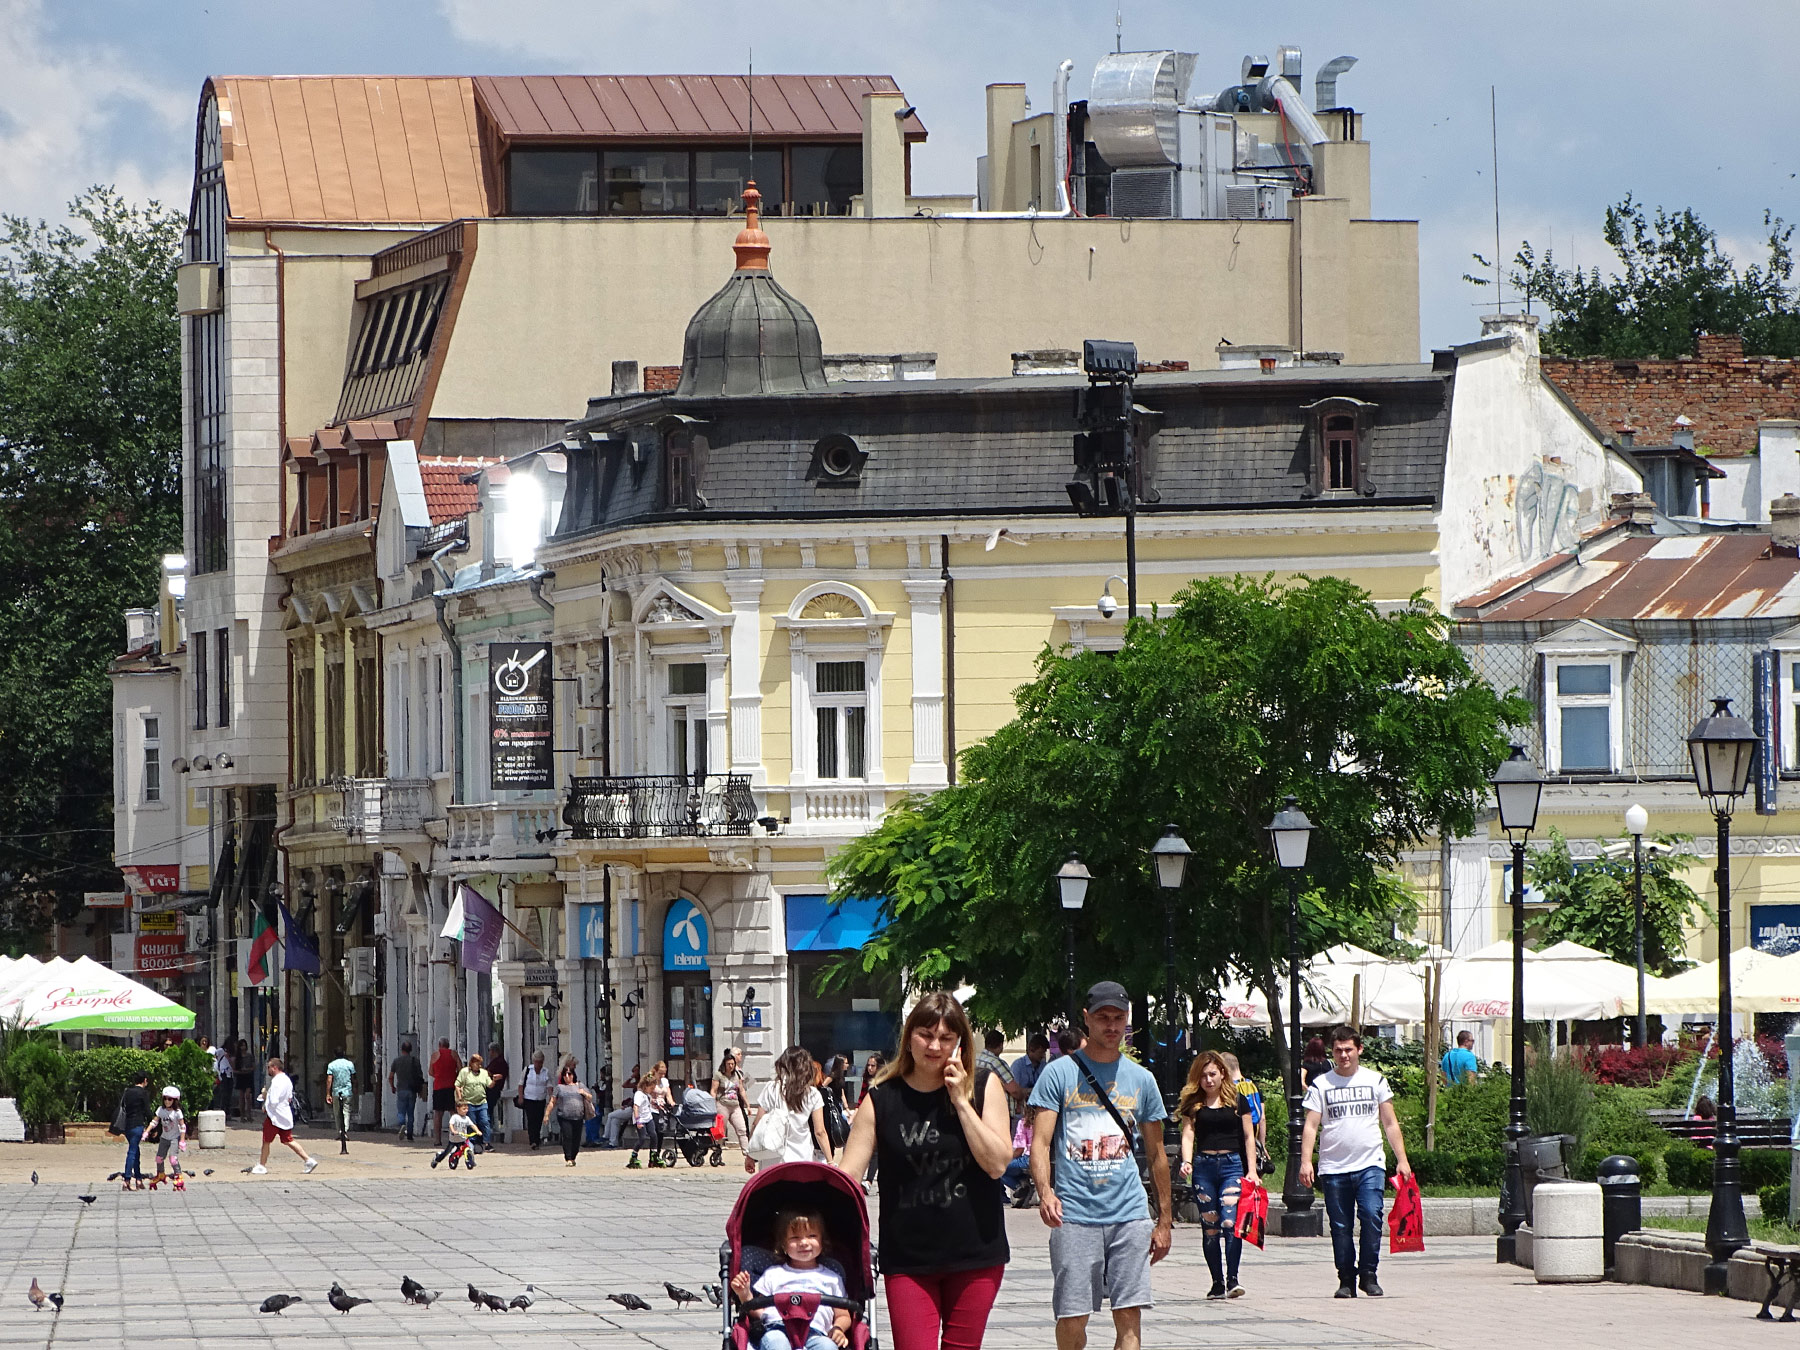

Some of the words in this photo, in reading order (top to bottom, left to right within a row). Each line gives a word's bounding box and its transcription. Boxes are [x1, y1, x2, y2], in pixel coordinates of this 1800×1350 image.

[141, 944, 179, 955] КНИГИ
[141, 958, 181, 969] BOOKS
[674, 952, 702, 966] telenor
[1462, 1000, 1510, 1017] Coca-Cola
[1326, 1087, 1372, 1104] HARLEM
[1328, 1104, 1348, 1118] NEW
[1349, 1103, 1374, 1116] YORK
[899, 1120, 940, 1147] We
